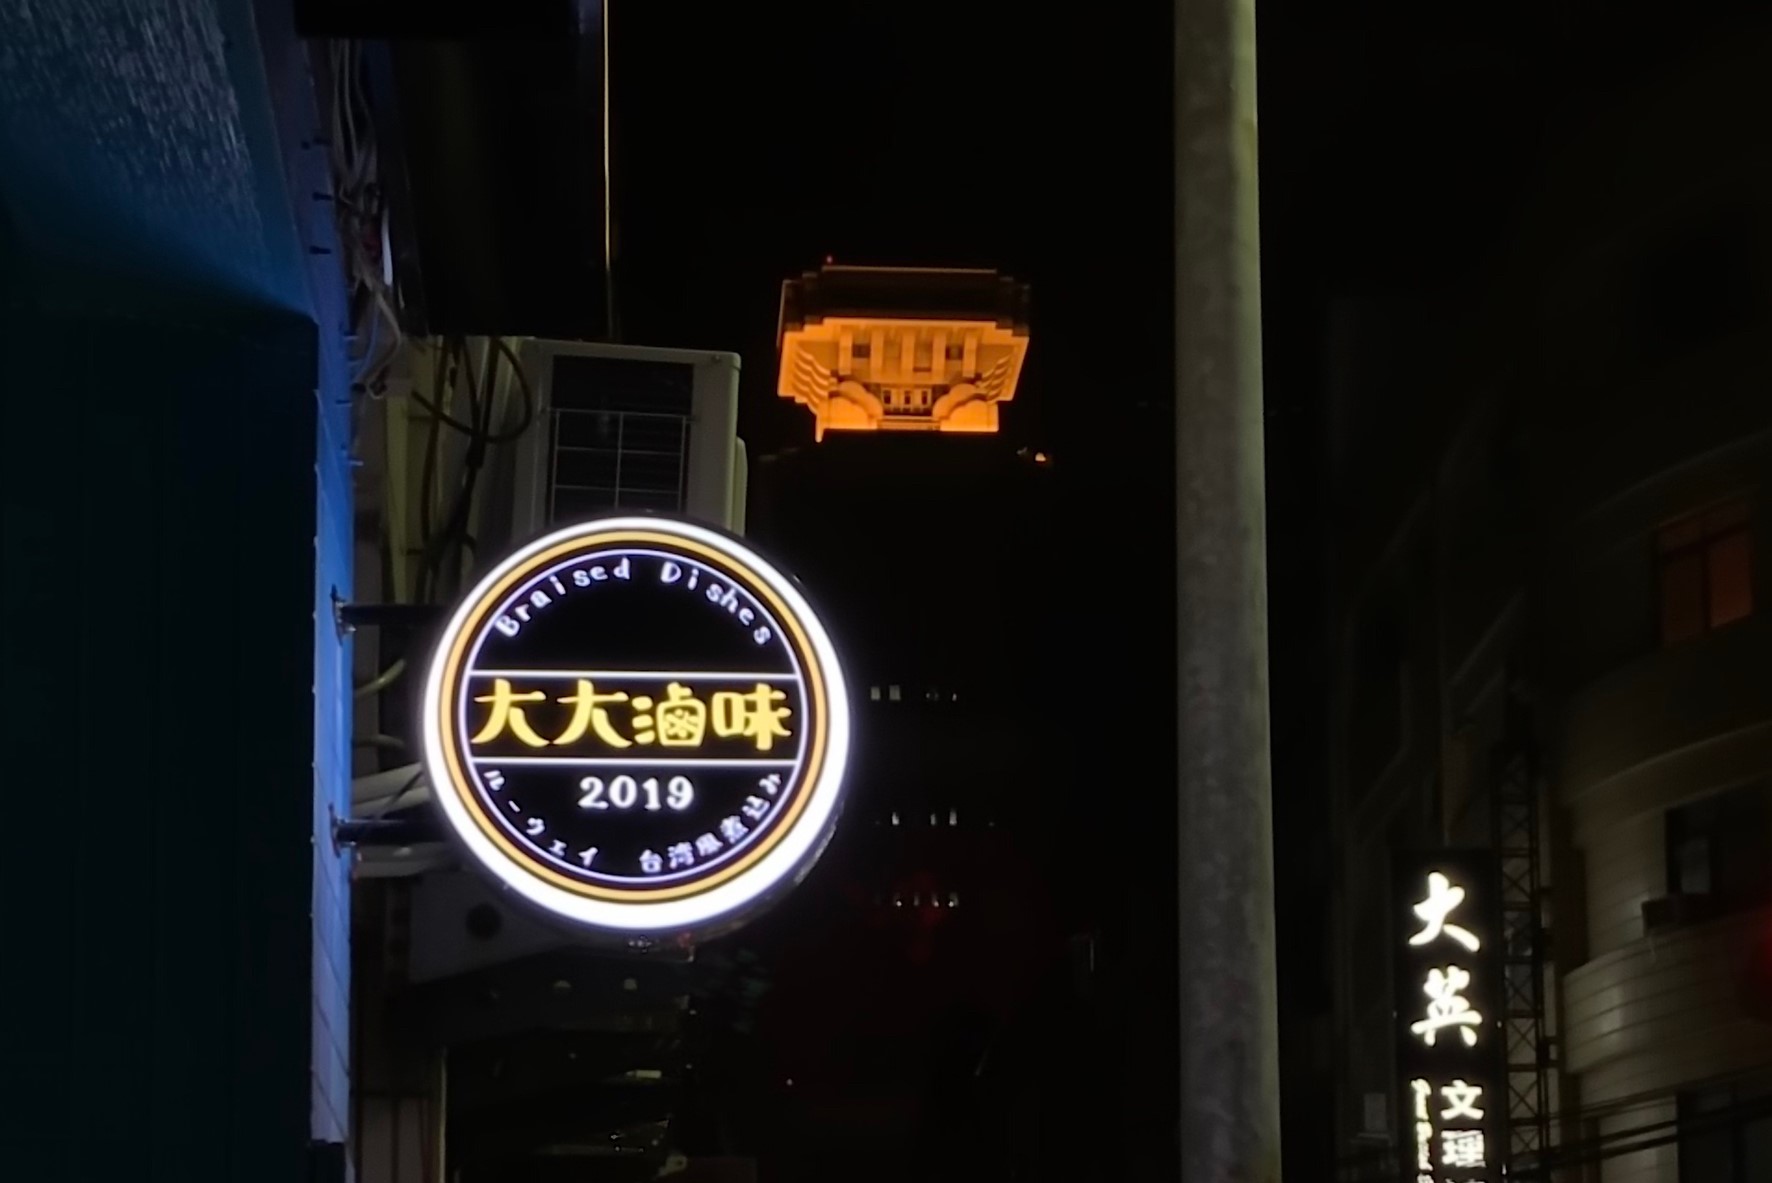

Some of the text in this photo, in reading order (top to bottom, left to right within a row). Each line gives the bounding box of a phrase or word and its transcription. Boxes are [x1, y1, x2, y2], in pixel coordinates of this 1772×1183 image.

[495, 557, 772, 645] Braised Dishes
[471, 678, 792, 750] 大大滷味
[577, 775, 694, 812] 2019
[1408, 871, 1481, 1047] 大英
